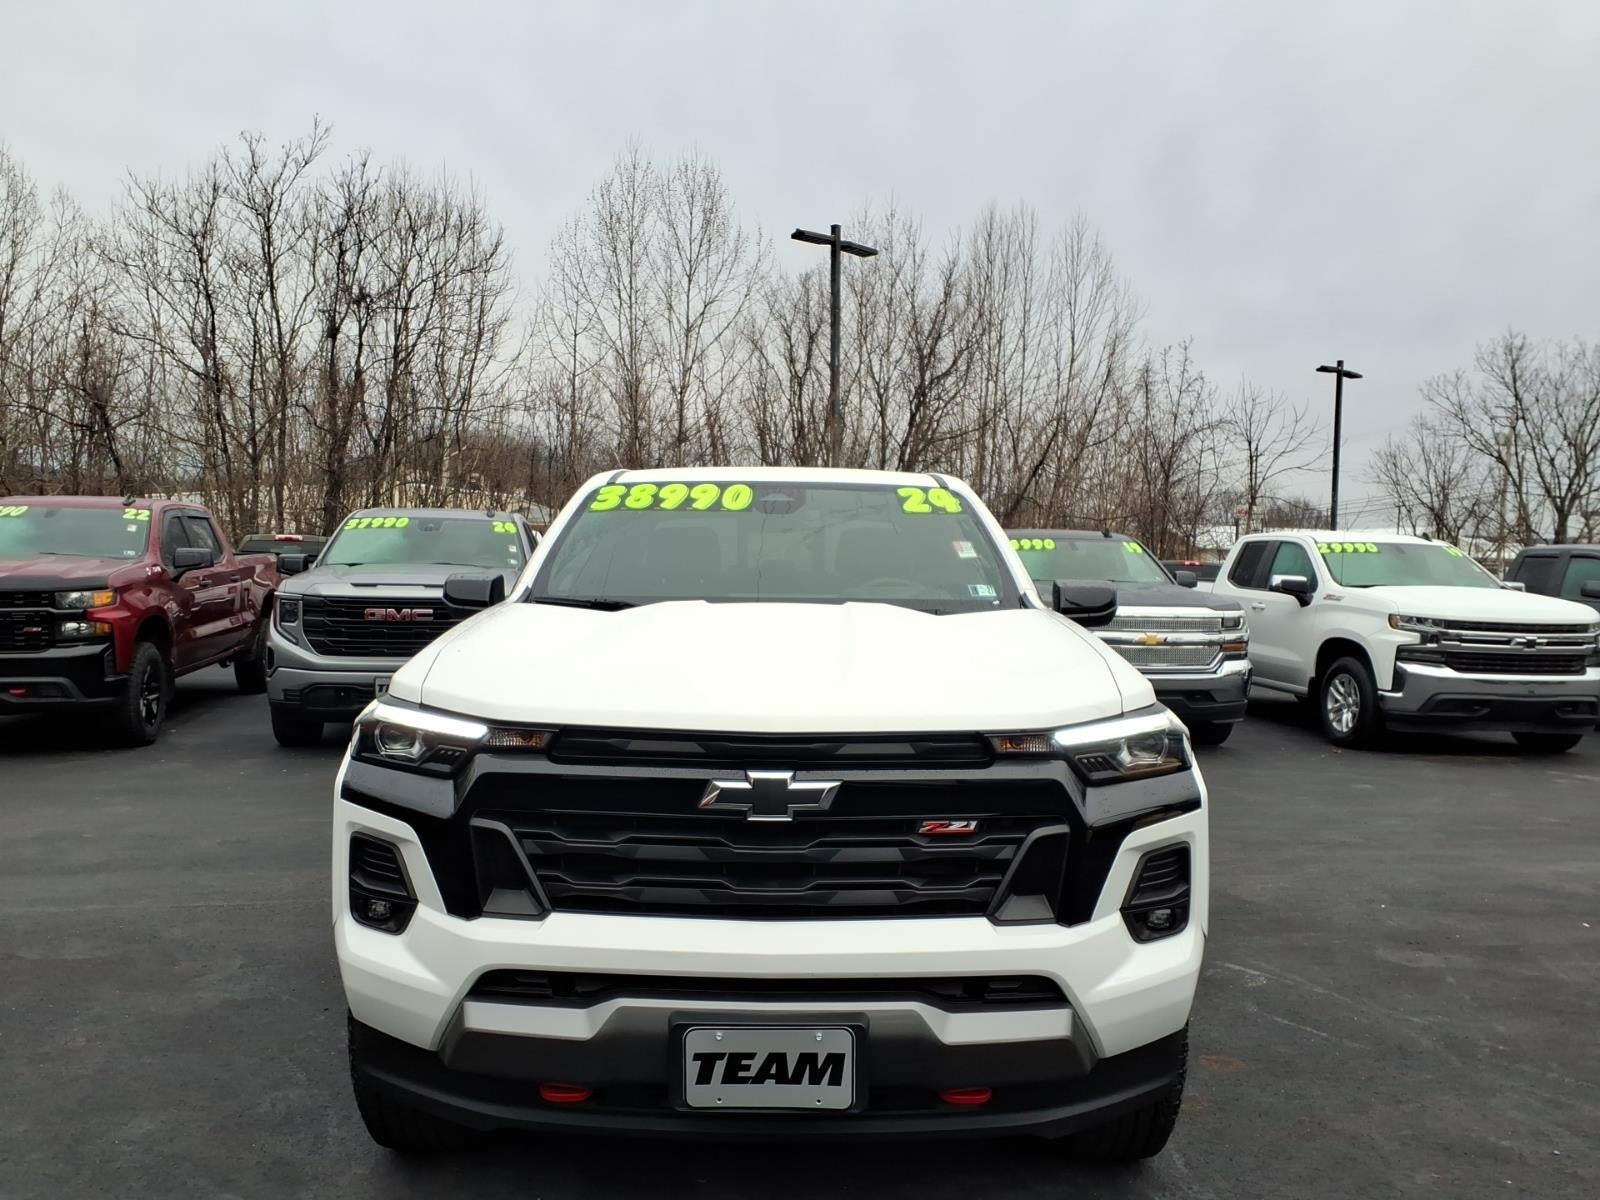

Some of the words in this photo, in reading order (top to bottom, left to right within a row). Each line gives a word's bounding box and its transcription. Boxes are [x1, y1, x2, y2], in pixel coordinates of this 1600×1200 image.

[590, 483, 753, 511] 38990
[897, 486, 962, 513] 24
[0, 505, 29, 517] 90
[122, 508, 151, 521] 22
[1316, 542, 1378, 553] 29990
[364, 608, 434, 621] GMC
[918, 820, 978, 834] Z71
[692, 1052, 846, 1087] TEAM
